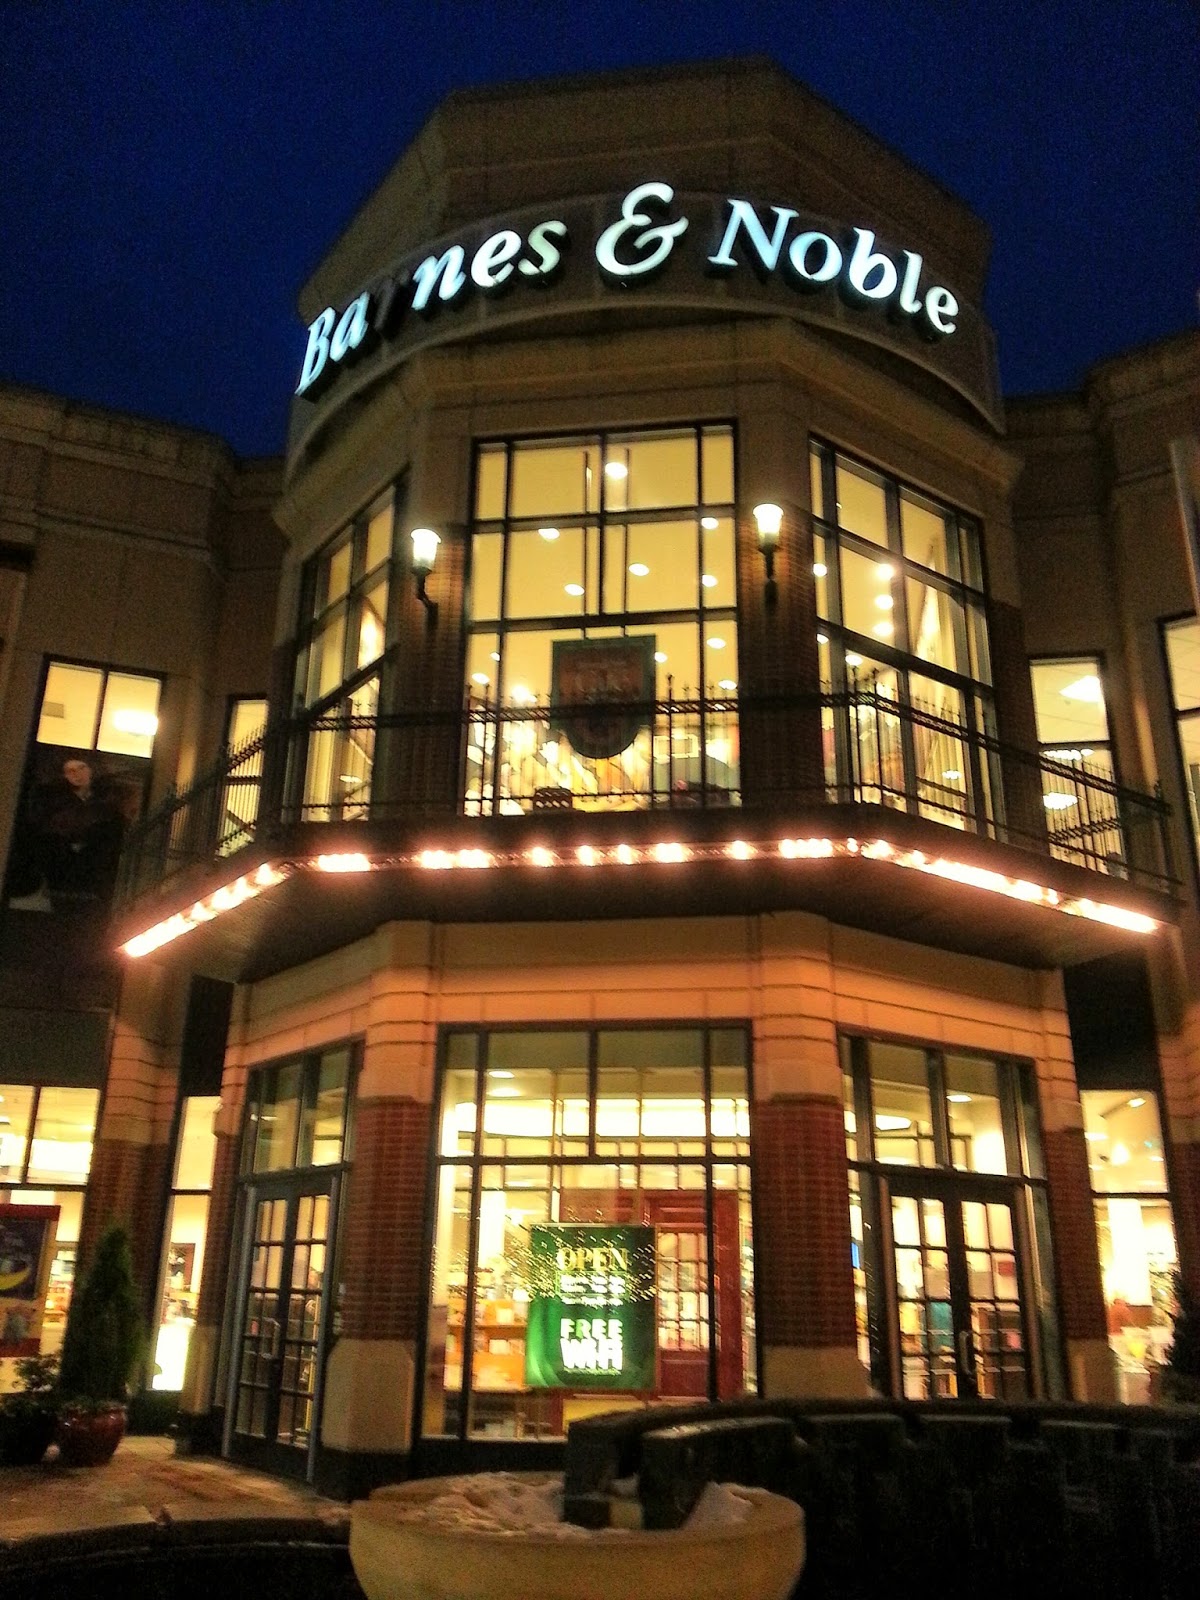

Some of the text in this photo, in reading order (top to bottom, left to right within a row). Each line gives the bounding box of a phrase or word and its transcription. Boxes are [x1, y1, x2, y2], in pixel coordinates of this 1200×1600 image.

[595, 182, 689, 276] &
[708, 199, 959, 334] Noble
[556, 1247, 628, 1271] OPEN
[560, 1318, 623, 1339] FREE
